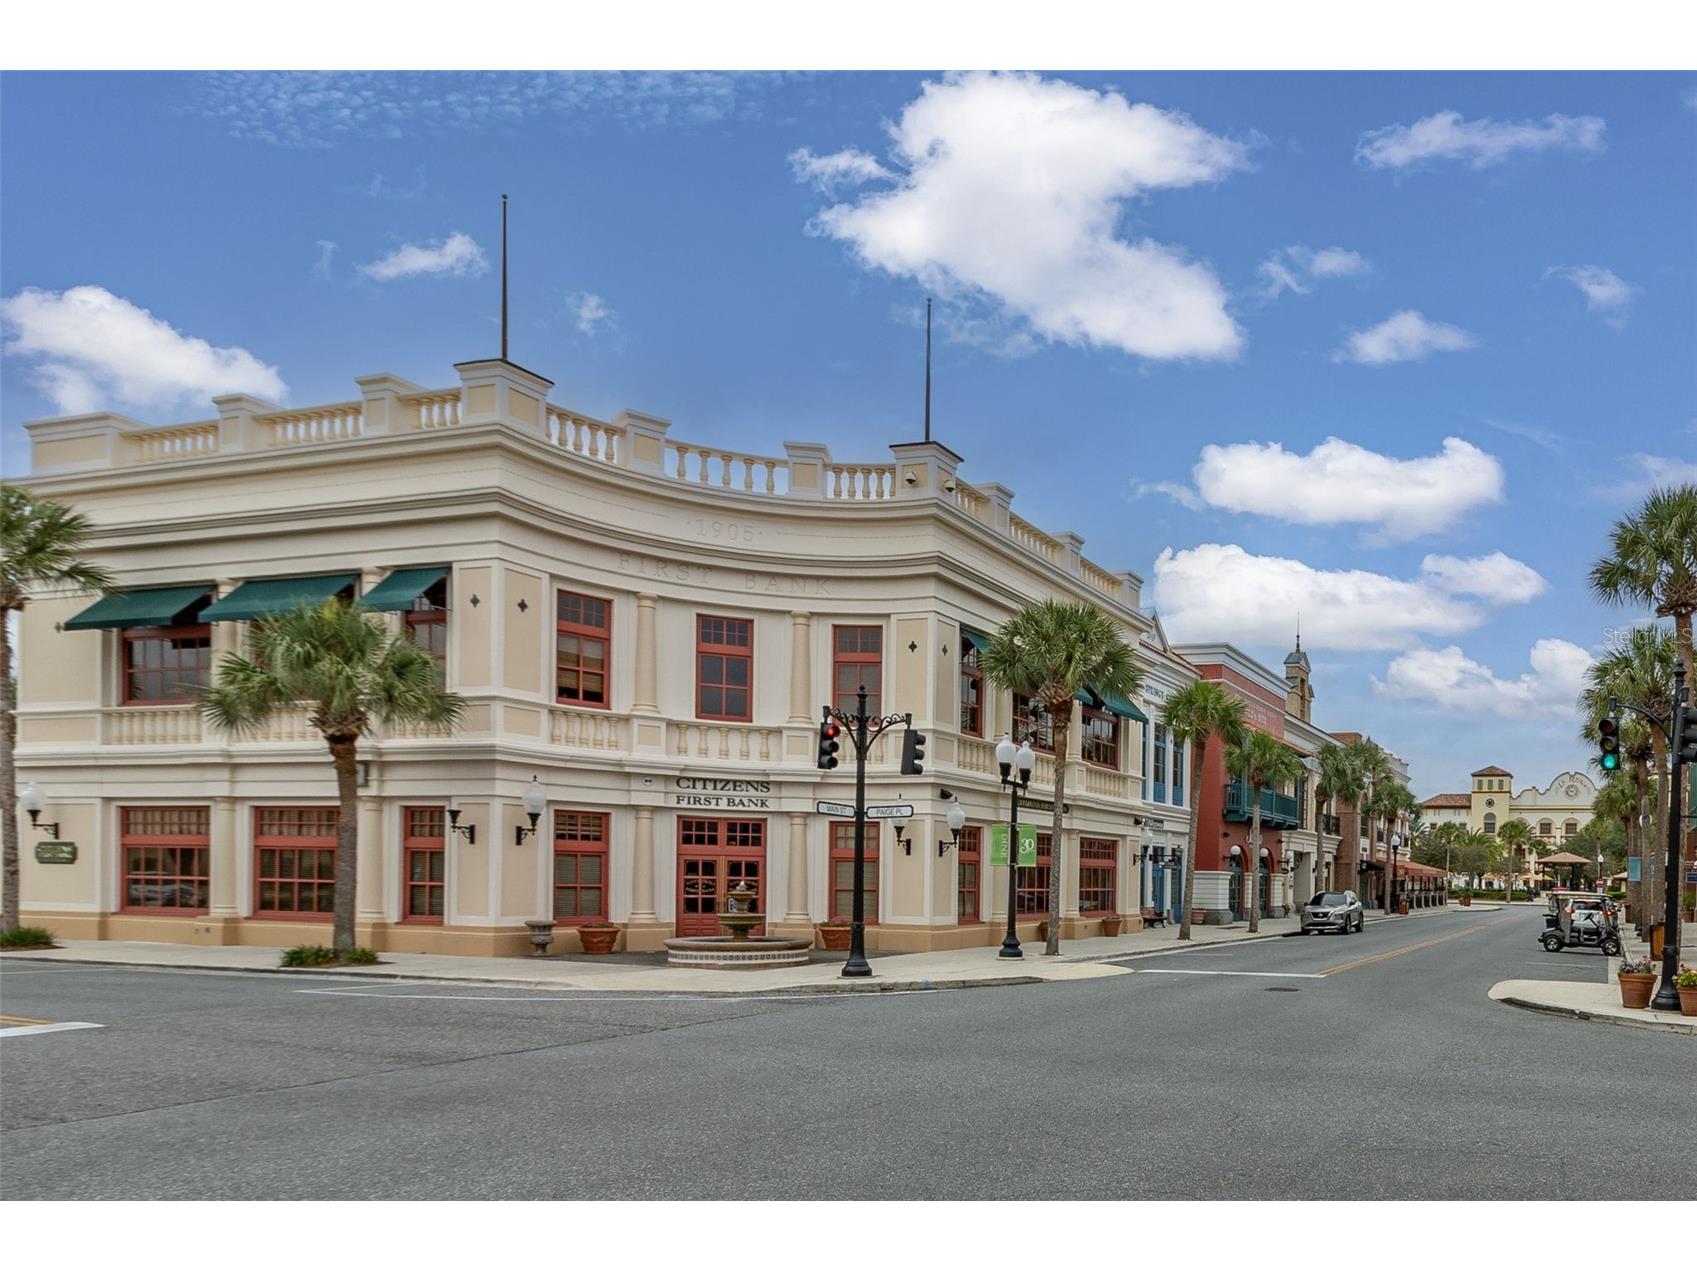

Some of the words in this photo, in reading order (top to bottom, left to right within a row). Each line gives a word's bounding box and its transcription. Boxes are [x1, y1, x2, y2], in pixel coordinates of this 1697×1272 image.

[617, 551, 713, 585] FIRST
[744, 572, 832, 595] BANK
[676, 776, 771, 794] CITIZENS
[676, 795, 723, 808] FIRST
[726, 797, 770, 809] BANK
[826, 805, 839, 813] MAIN
[876, 808, 895, 816] PAIGE
